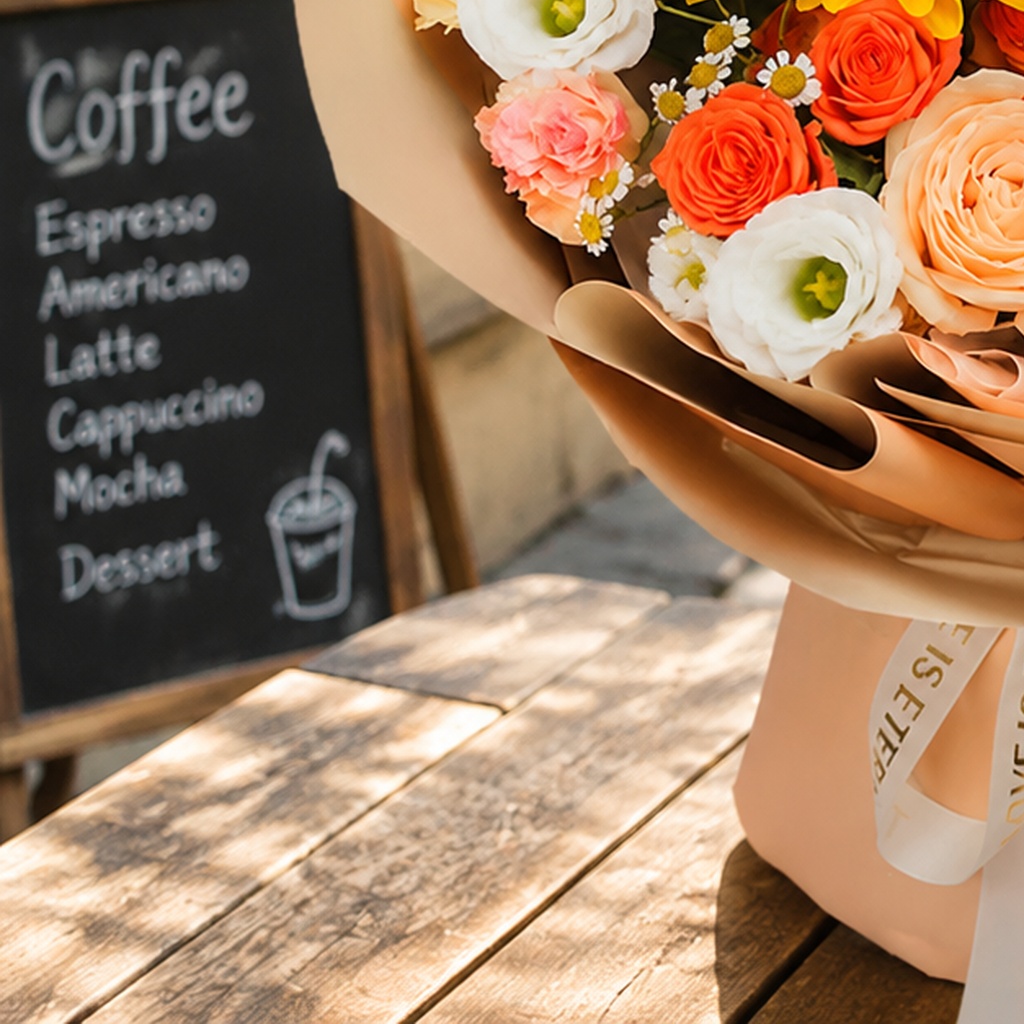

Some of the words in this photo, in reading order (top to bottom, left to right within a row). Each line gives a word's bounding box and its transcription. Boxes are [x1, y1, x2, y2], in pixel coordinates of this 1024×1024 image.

[28, 46, 253, 164] Coffee
[36, 195, 216, 260] Espresso
[38, 256, 250, 321] Americano
[45, 326, 161, 386] Latte
[46, 379, 265, 459] Cappuccino
[54, 455, 185, 518] Mocha
[58, 521, 221, 602] Dessert
[911, 643, 954, 689] IS
